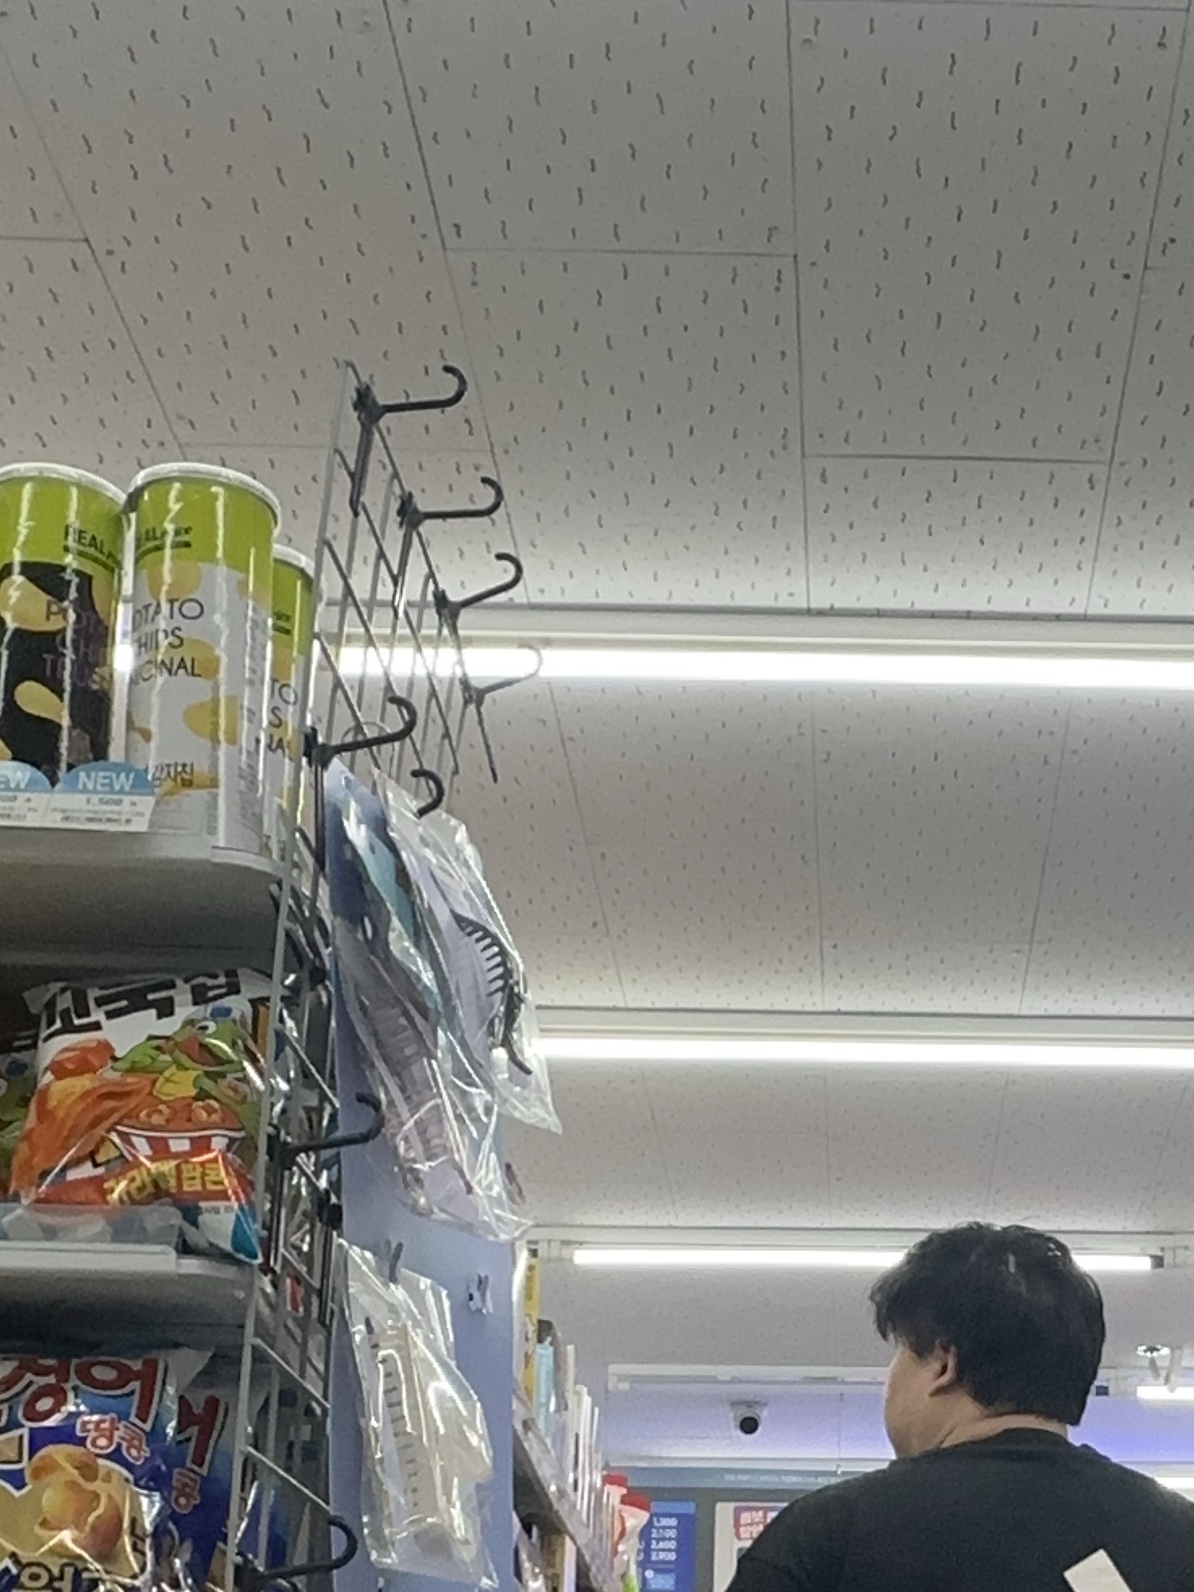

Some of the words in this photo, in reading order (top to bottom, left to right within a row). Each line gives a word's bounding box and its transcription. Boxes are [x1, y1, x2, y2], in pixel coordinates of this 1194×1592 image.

[78, 771, 135, 792] NEW
[0, 1358, 159, 1424] 징어
[78, 1416, 150, 1465] 땅콩
